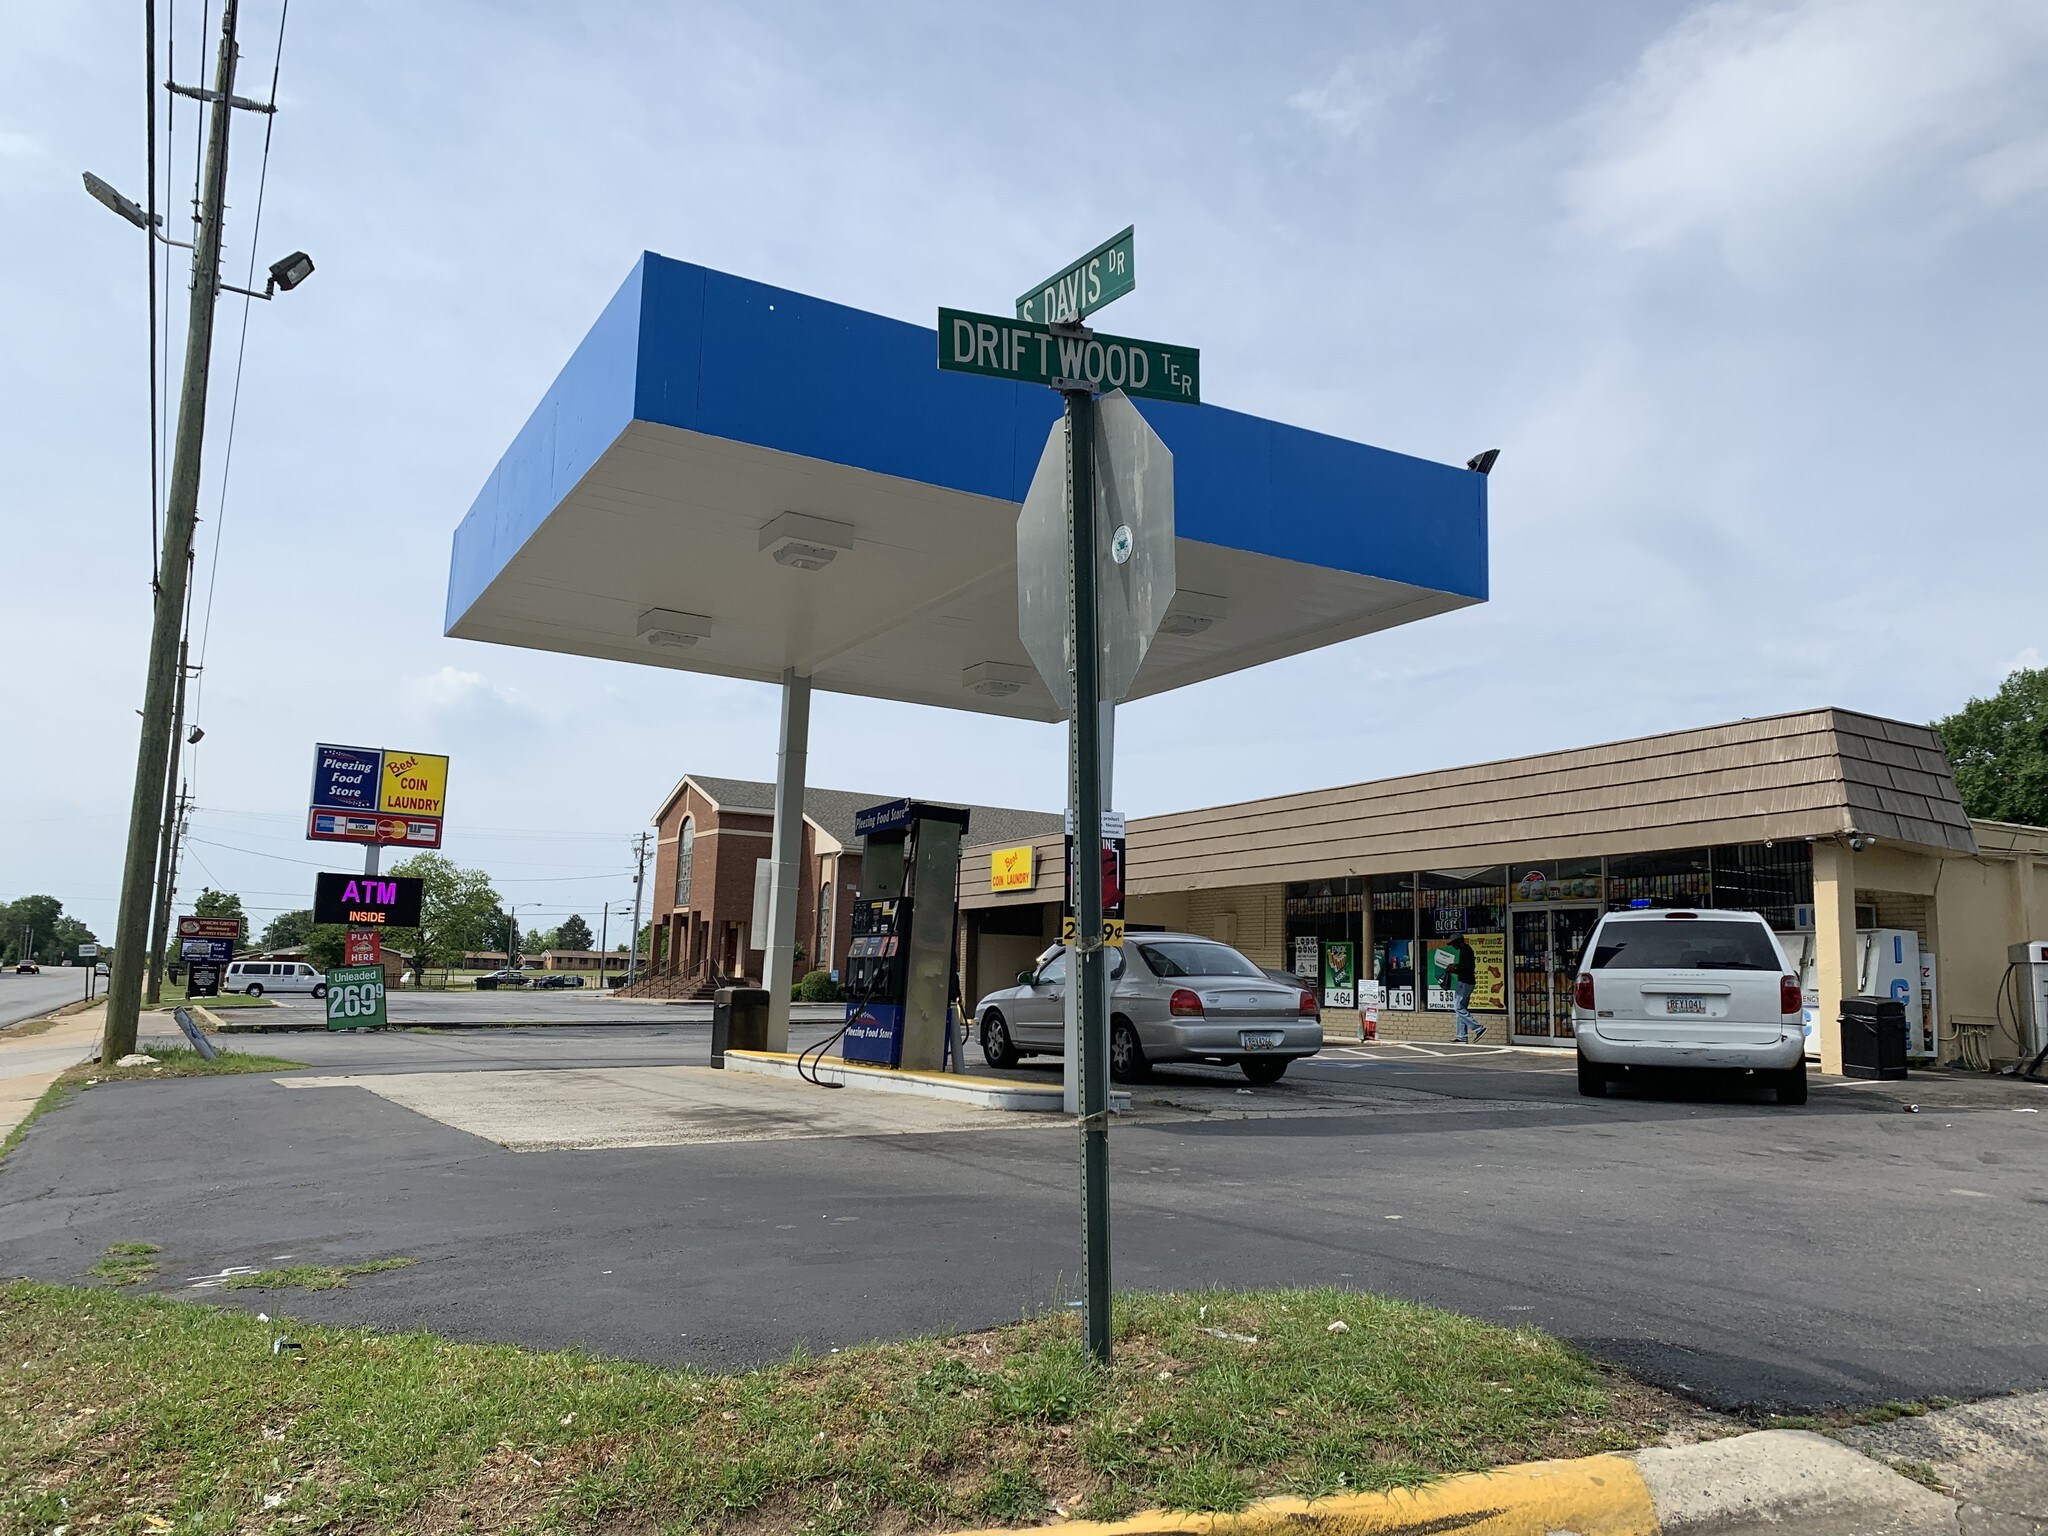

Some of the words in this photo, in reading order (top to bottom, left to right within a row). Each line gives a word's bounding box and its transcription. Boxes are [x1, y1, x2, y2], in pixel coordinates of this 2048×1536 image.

[1023, 299, 1034, 322] S
[1045, 258, 1101, 324] DAVIS
[1108, 249, 1125, 276] DR
[953, 318, 1149, 389] DRIFTWOOD
[1161, 353, 1192, 396] TER
[323, 758, 373, 773] Pleezing
[386, 756, 419, 775] Best
[331, 772, 363, 784] Food
[400, 777, 428, 791] COIN
[329, 785, 361, 797] Store
[387, 795, 440, 812] LAUNDRY
[855, 815, 876, 830] Pleezing
[876, 810, 890, 825] Food
[891, 808, 905, 821] Store
[904, 798, 910, 811] 2
[1102, 839, 1116, 850] INE
[1004, 851, 1018, 868] Best
[992, 875, 1004, 887] COIN
[1006, 872, 1030, 885] LAUNDRY
[341, 880, 397, 905] ATM
[349, 911, 386, 923] INSIDE
[351, 933, 374, 941] PLAY
[1103, 923, 1123, 941] 9¢
[351, 953, 374, 961] HERE
[334, 970, 376, 983] Unleaded
[1395, 992, 1412, 1006] 419
[1440, 991, 1454, 1002] 539
[845, 1026, 865, 1039] Pleezing
[865, 1027, 879, 1038] Food
[879, 1027, 893, 1039] Store
